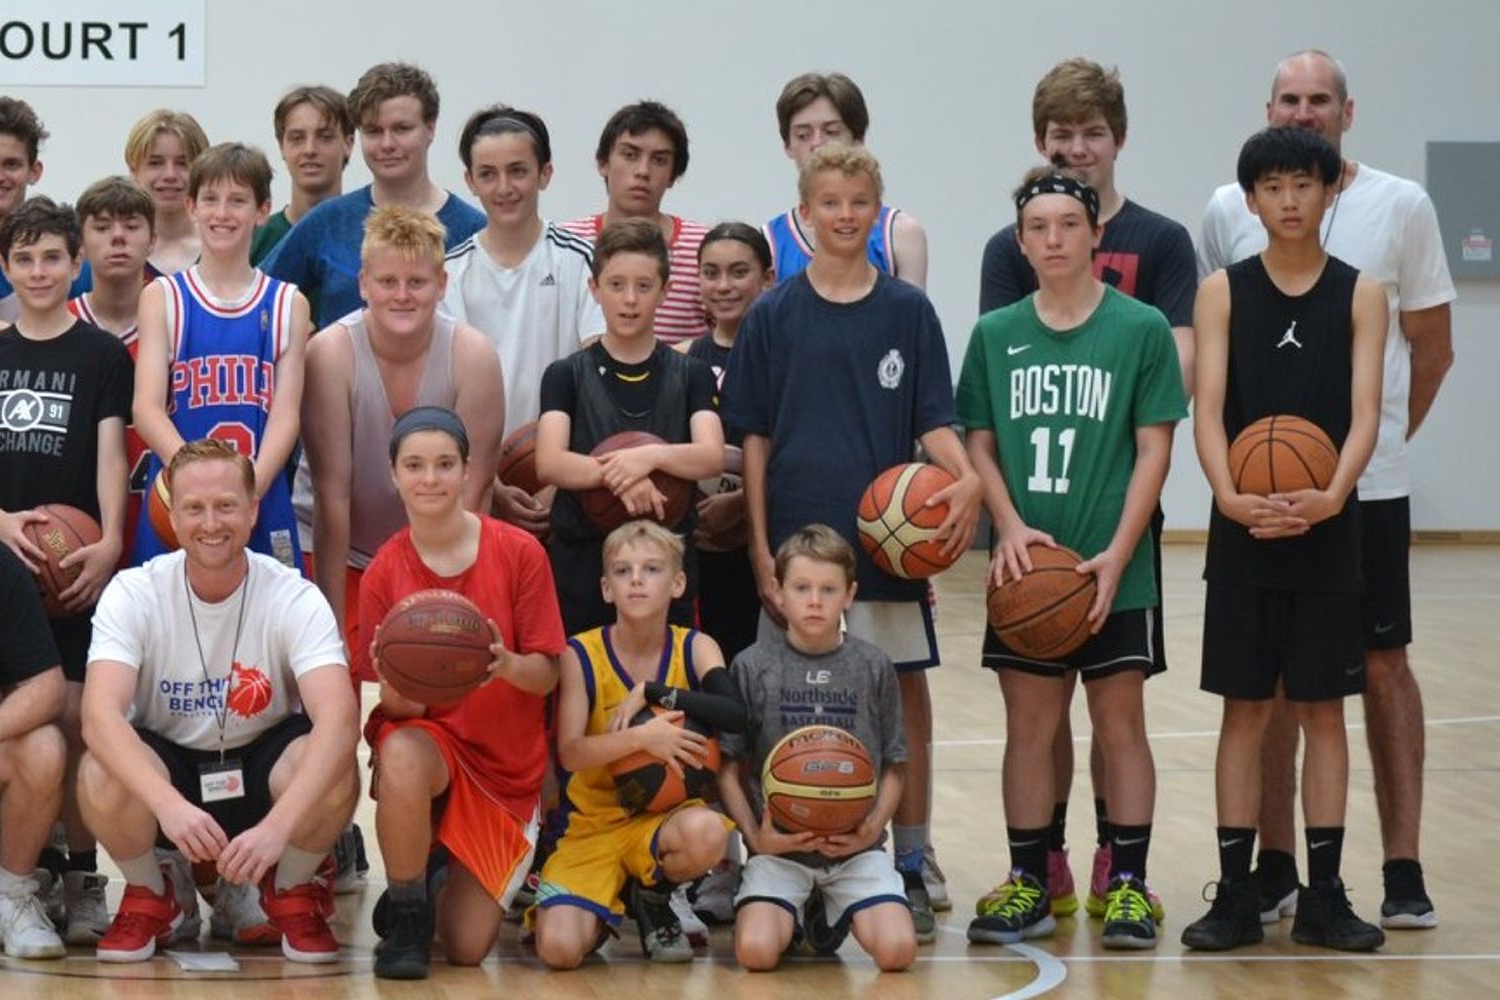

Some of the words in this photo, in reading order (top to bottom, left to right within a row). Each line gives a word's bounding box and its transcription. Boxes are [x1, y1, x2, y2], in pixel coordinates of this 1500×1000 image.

[168, 22, 186, 61] 1
[49, 404, 64, 419] 91
[1010, 364, 1112, 422] BOSTON
[1027, 426, 1076, 494] 11
[160, 680, 194, 696] OFF
